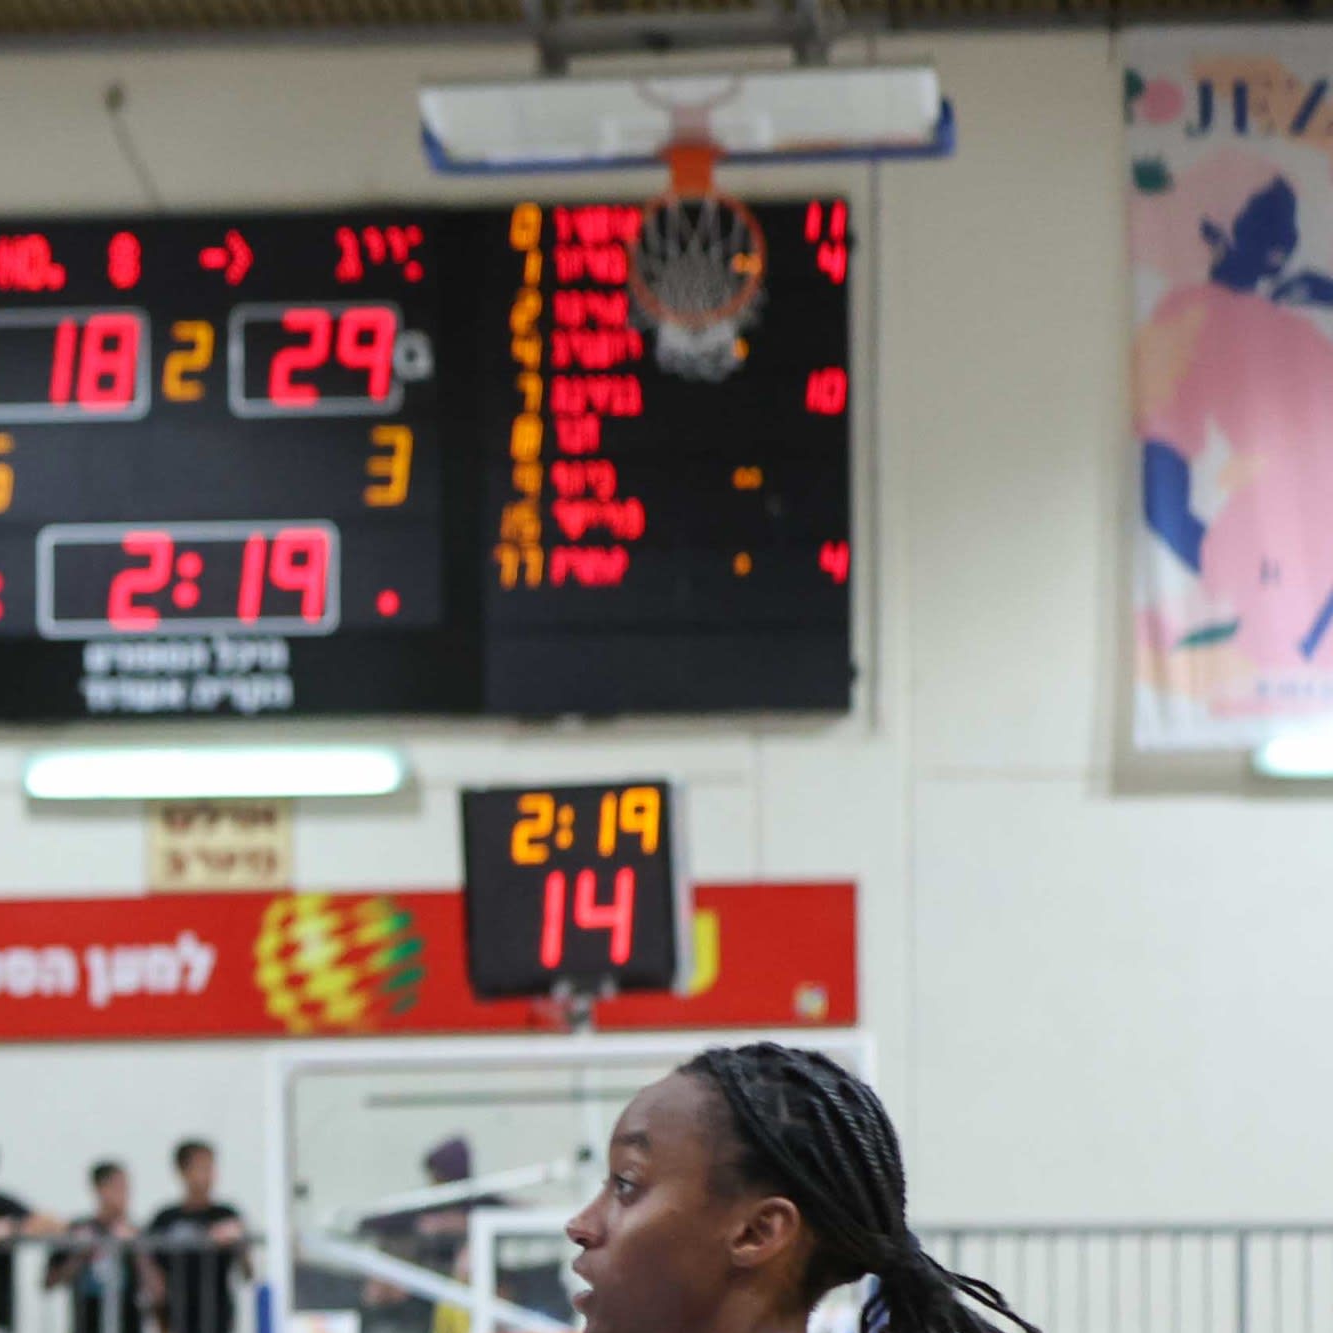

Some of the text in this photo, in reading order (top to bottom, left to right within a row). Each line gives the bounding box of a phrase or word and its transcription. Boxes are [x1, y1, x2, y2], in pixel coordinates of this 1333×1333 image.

[805, 200, 846, 243] 11
[49, 313, 141, 411] 18
[163, 321, 213, 401] 2
[268, 306, 397, 407] 29
[365, 426, 413, 506] 3
[107, 528, 330, 630] 2:19
[510, 786, 661, 866] 2:19
[540, 866, 636, 968] 14
[85, 931, 216, 1008] למען
